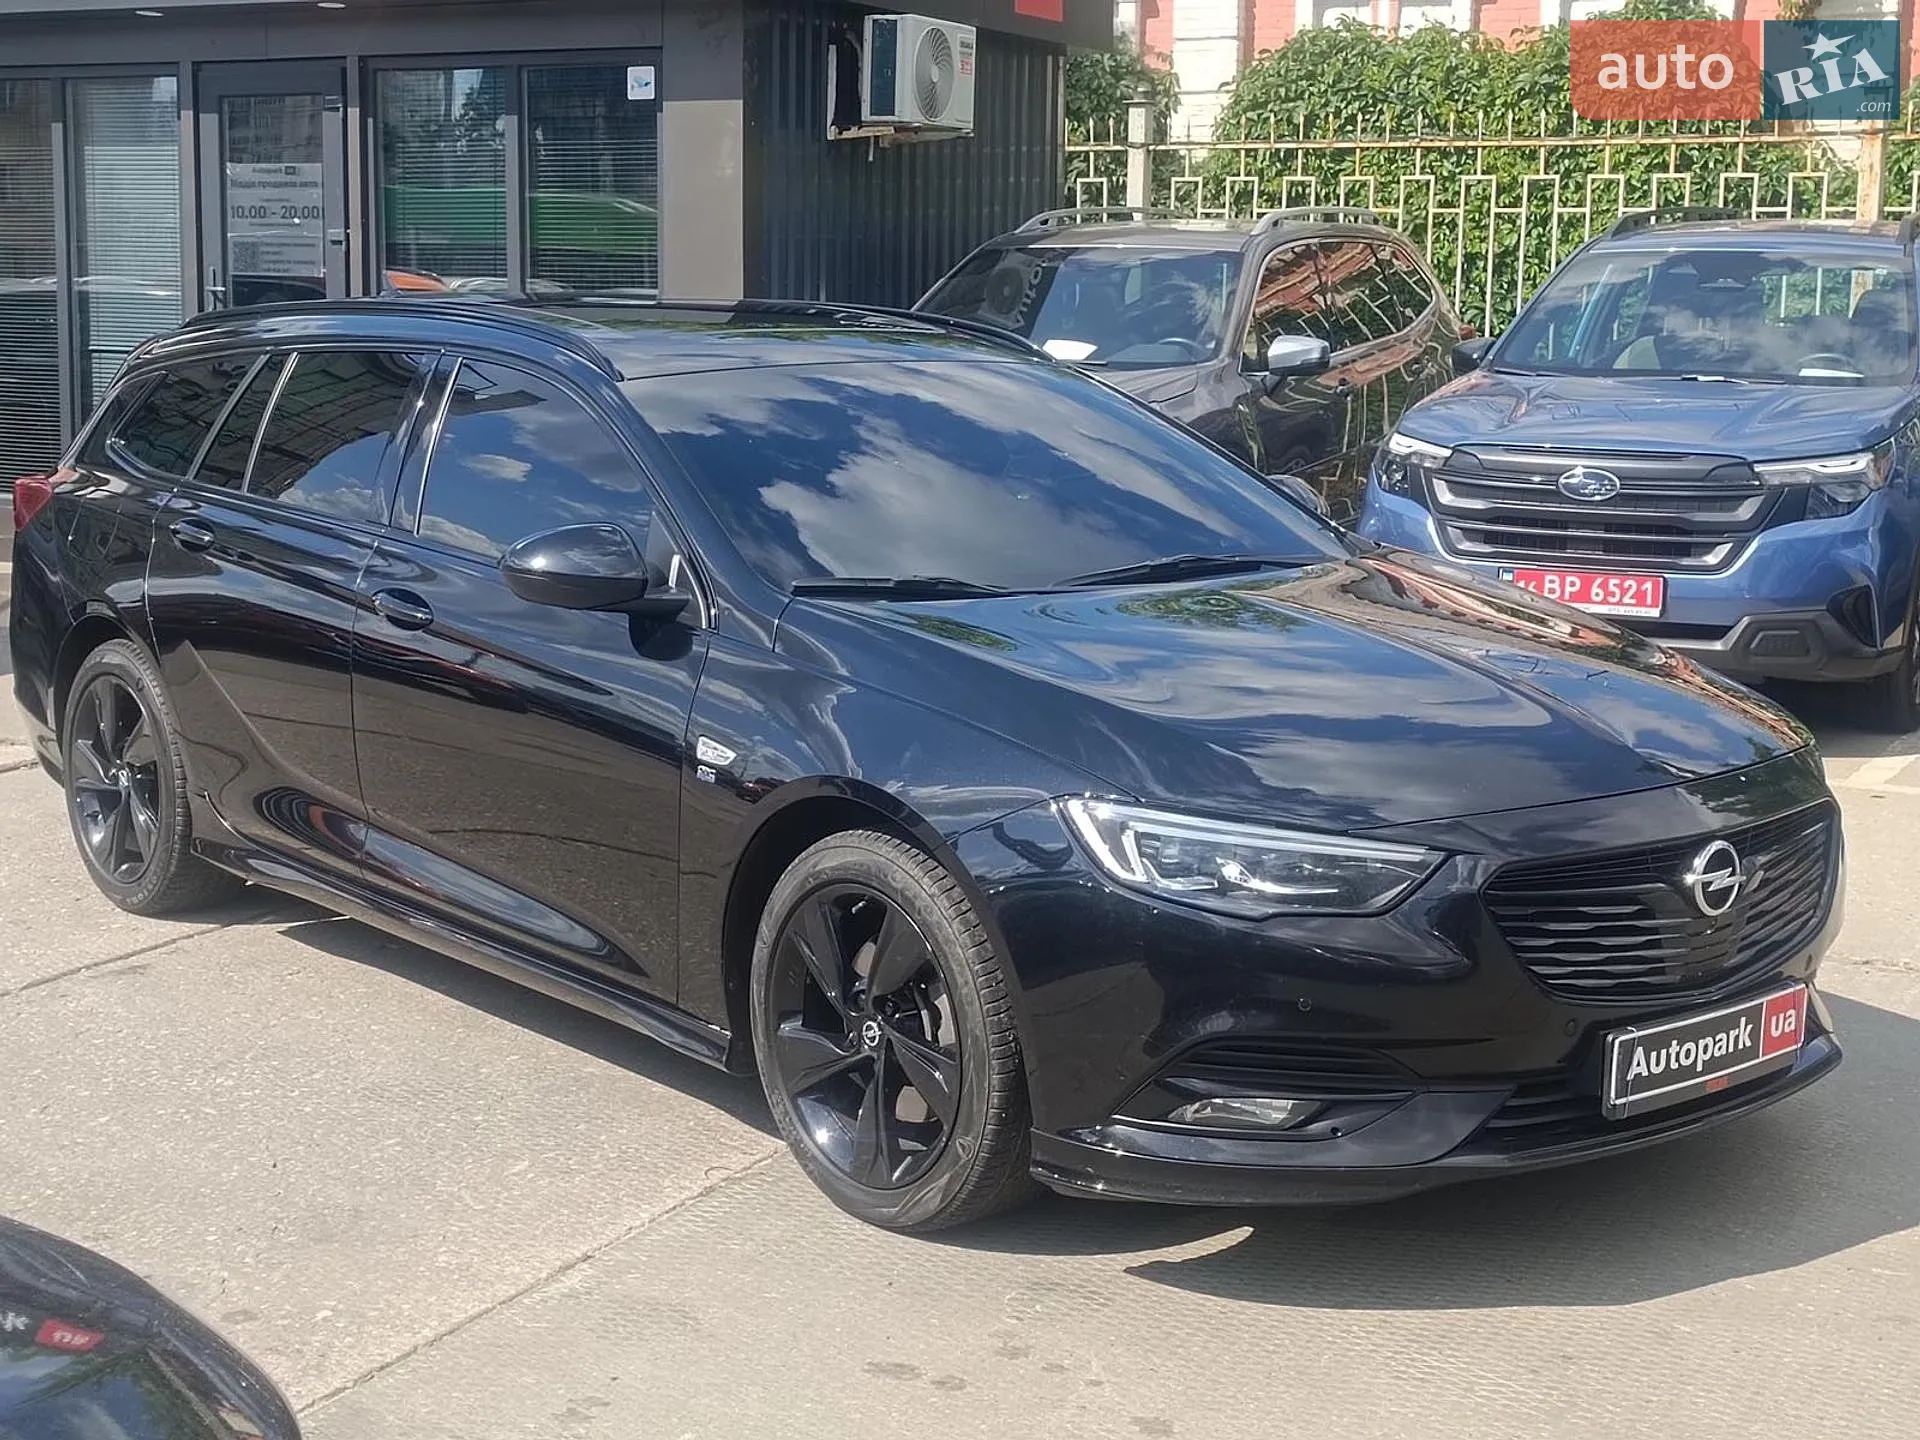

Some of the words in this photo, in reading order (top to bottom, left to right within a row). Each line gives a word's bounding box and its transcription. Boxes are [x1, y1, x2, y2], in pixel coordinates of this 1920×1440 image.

[231, 205, 267, 219] 10.00
[280, 205, 320, 219] 20.00
[1543, 574, 1582, 601] BP
[1590, 577, 1654, 606] 6521
[1626, 1016, 1754, 1081] Autopark
[1770, 1008, 1797, 1038] ua
